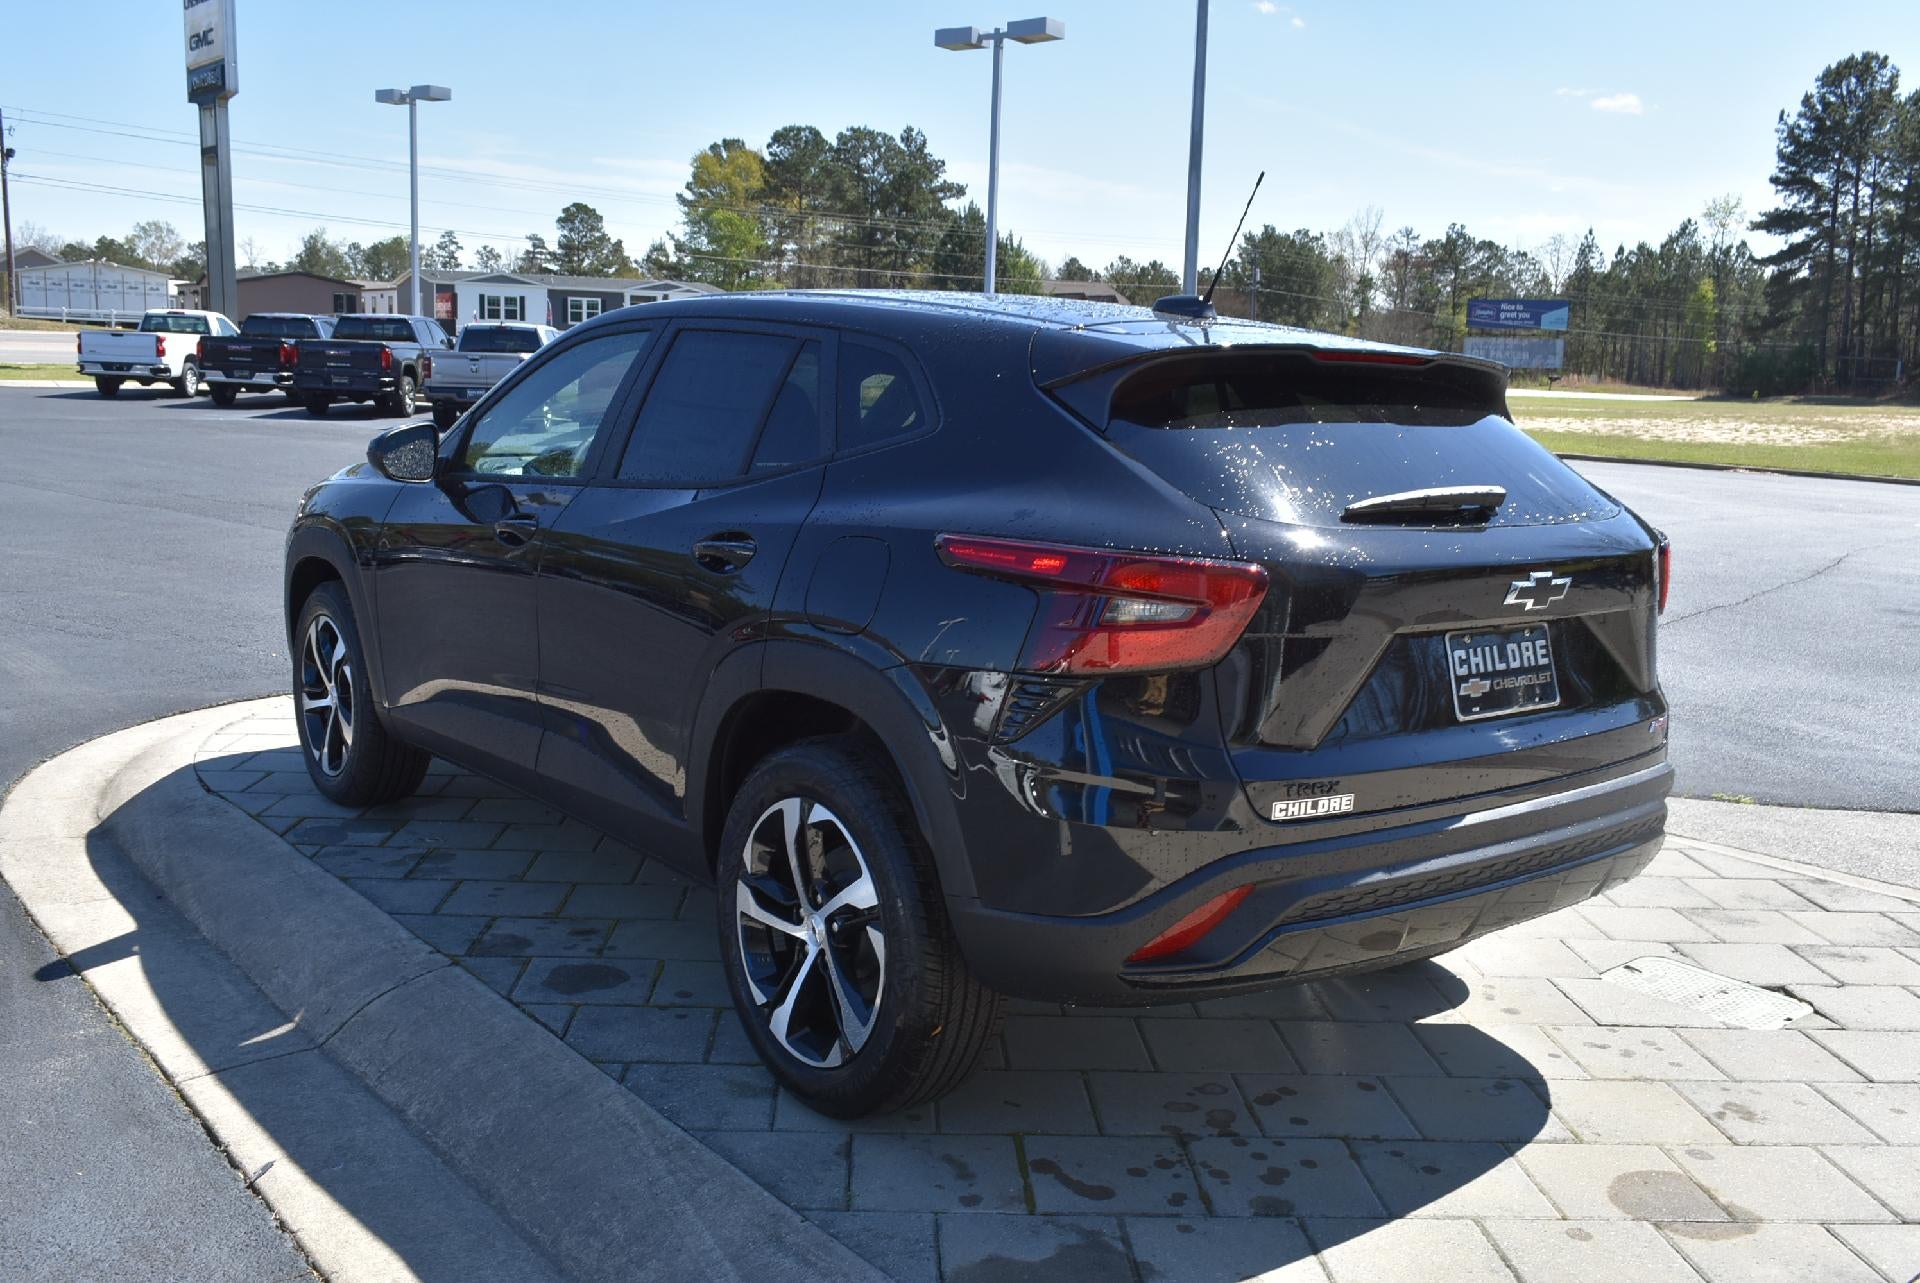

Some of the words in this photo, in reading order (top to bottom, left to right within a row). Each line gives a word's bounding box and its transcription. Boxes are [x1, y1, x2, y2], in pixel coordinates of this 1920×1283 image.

[189, 28, 214, 51] GMC
[1500, 311, 1517, 320] greet
[1518, 311, 1530, 320] you
[1501, 303, 1516, 311] Nice
[1453, 639, 1549, 676] CHILDRE
[1492, 672, 1551, 690] CHEVROLET
[1283, 780, 1341, 797] TRAX
[1274, 796, 1352, 818] CHILDRE
